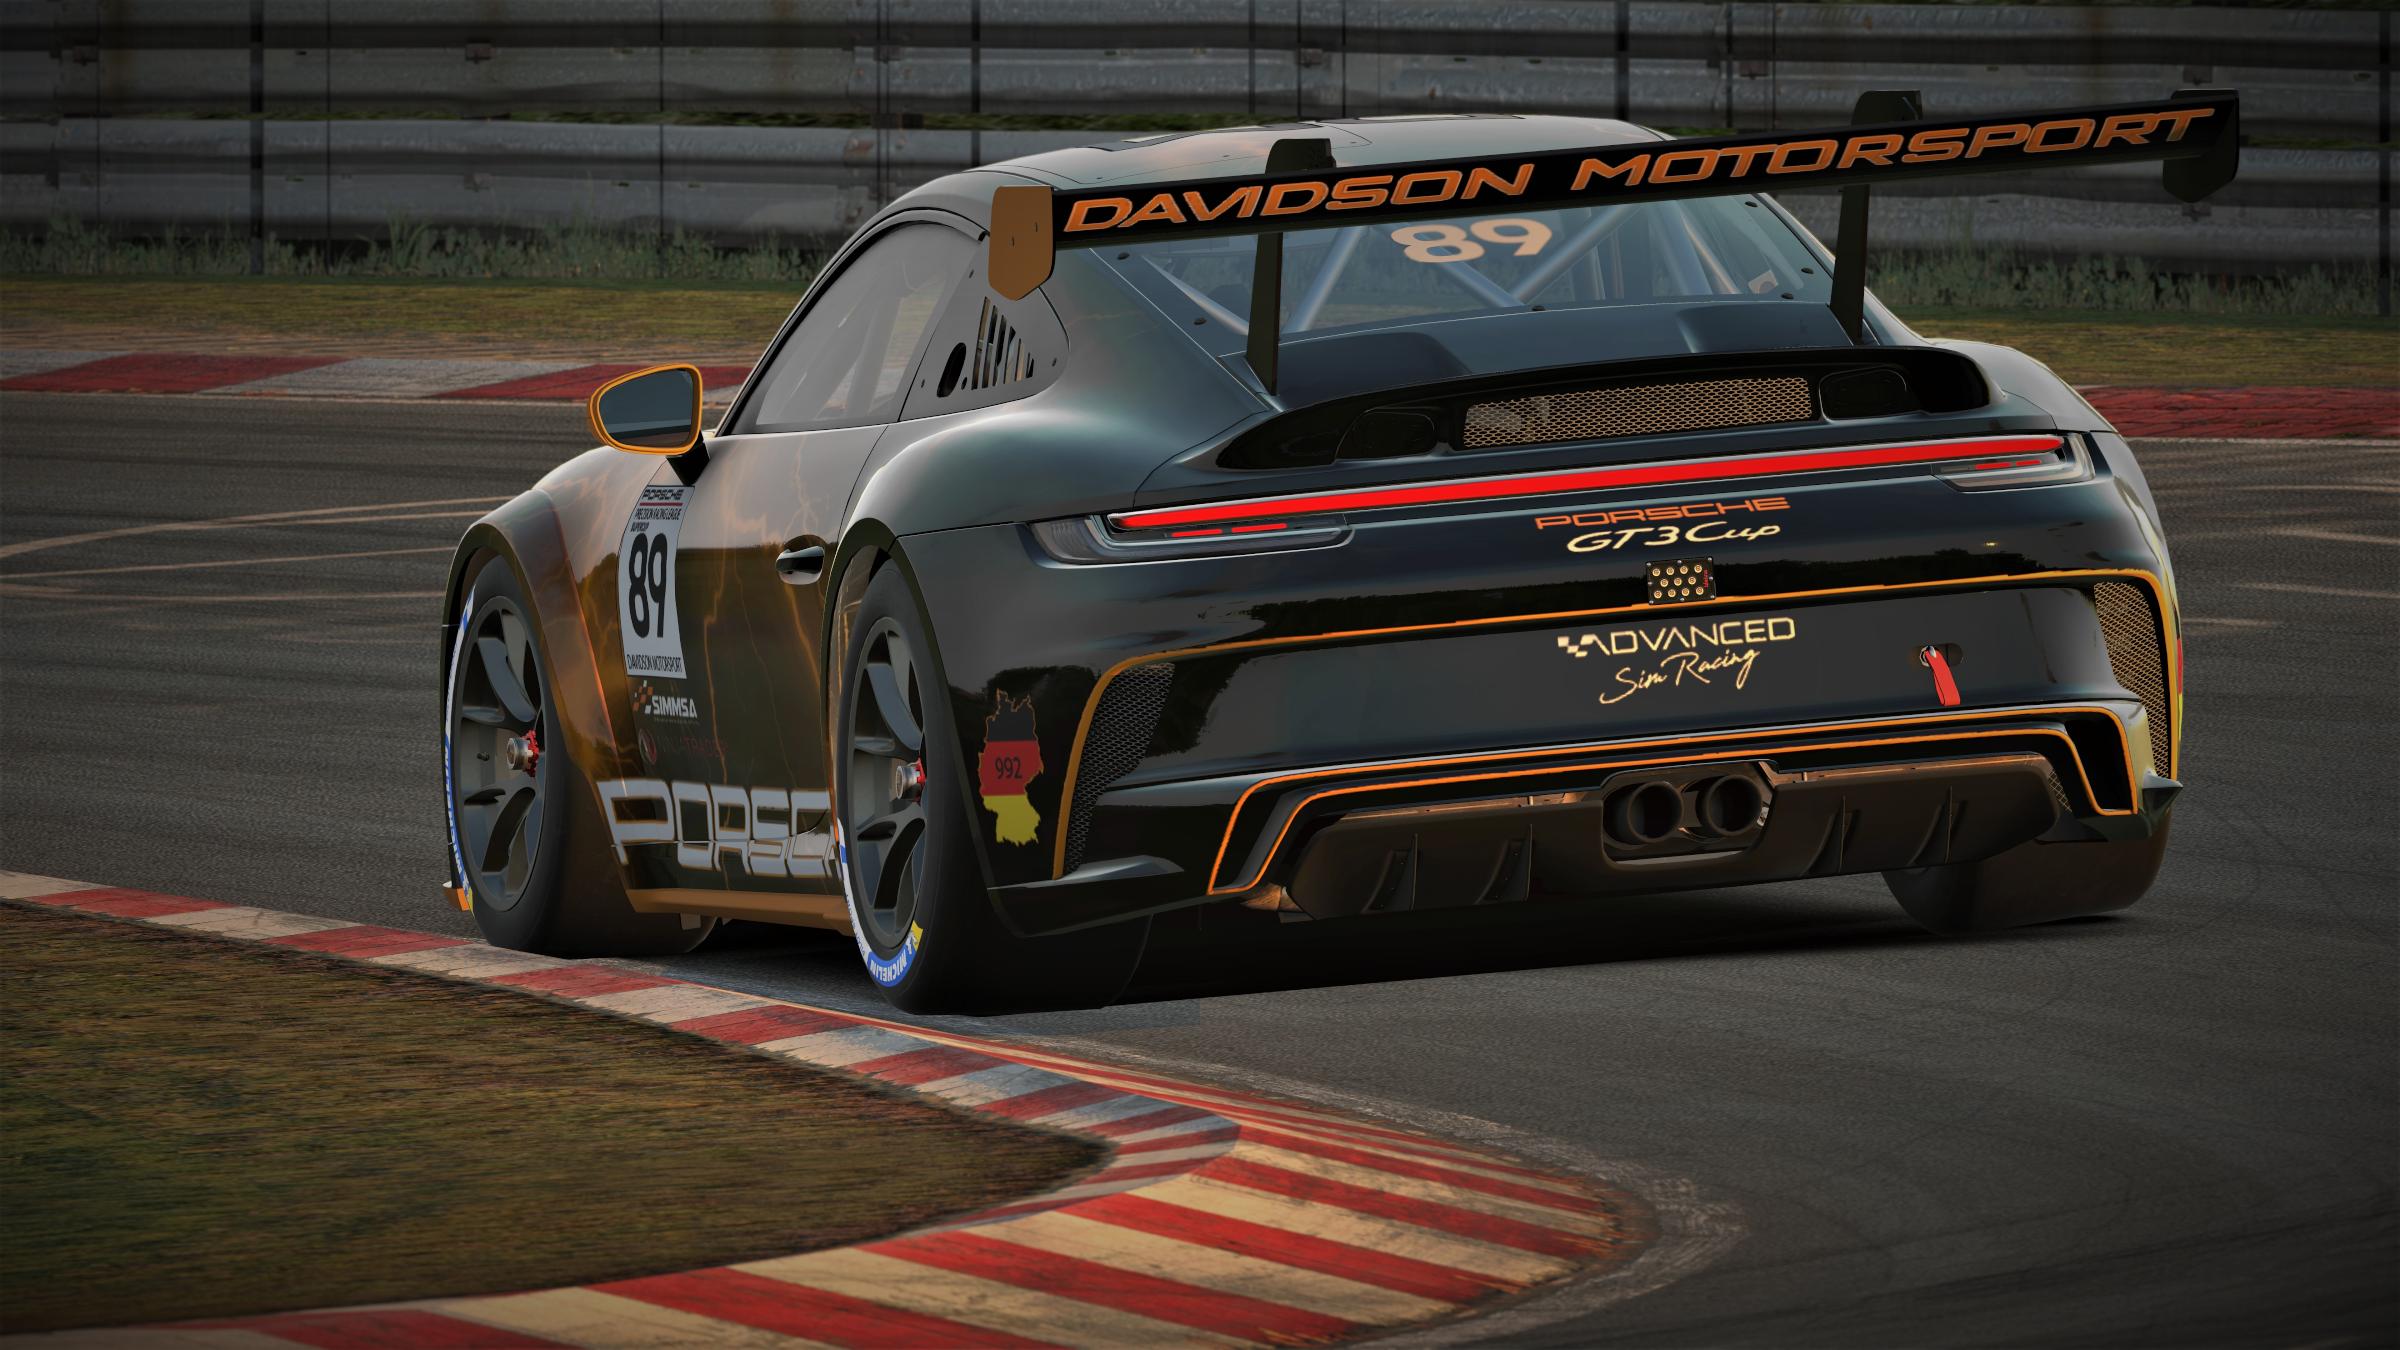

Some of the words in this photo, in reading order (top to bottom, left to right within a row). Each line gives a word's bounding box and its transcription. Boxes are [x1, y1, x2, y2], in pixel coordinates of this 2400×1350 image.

[1063, 163, 1535, 232] DAVIDSON
[1570, 108, 2215, 191] MOTORSPORT
[1390, 218, 1553, 264] 89
[642, 489, 684, 500] PORSCHE
[1535, 497, 1791, 530] PORSCHE
[629, 533, 668, 638] 89
[1558, 617, 1796, 658] ADVANCED
[627, 654, 652, 671] DAVIDSON
[1599, 667, 1668, 704] Sim
[1660, 649, 1760, 690] Racing
[651, 695, 698, 719] SIMMSA
[994, 756, 1022, 779] 992
[870, 949, 908, 982] MICHELIN
